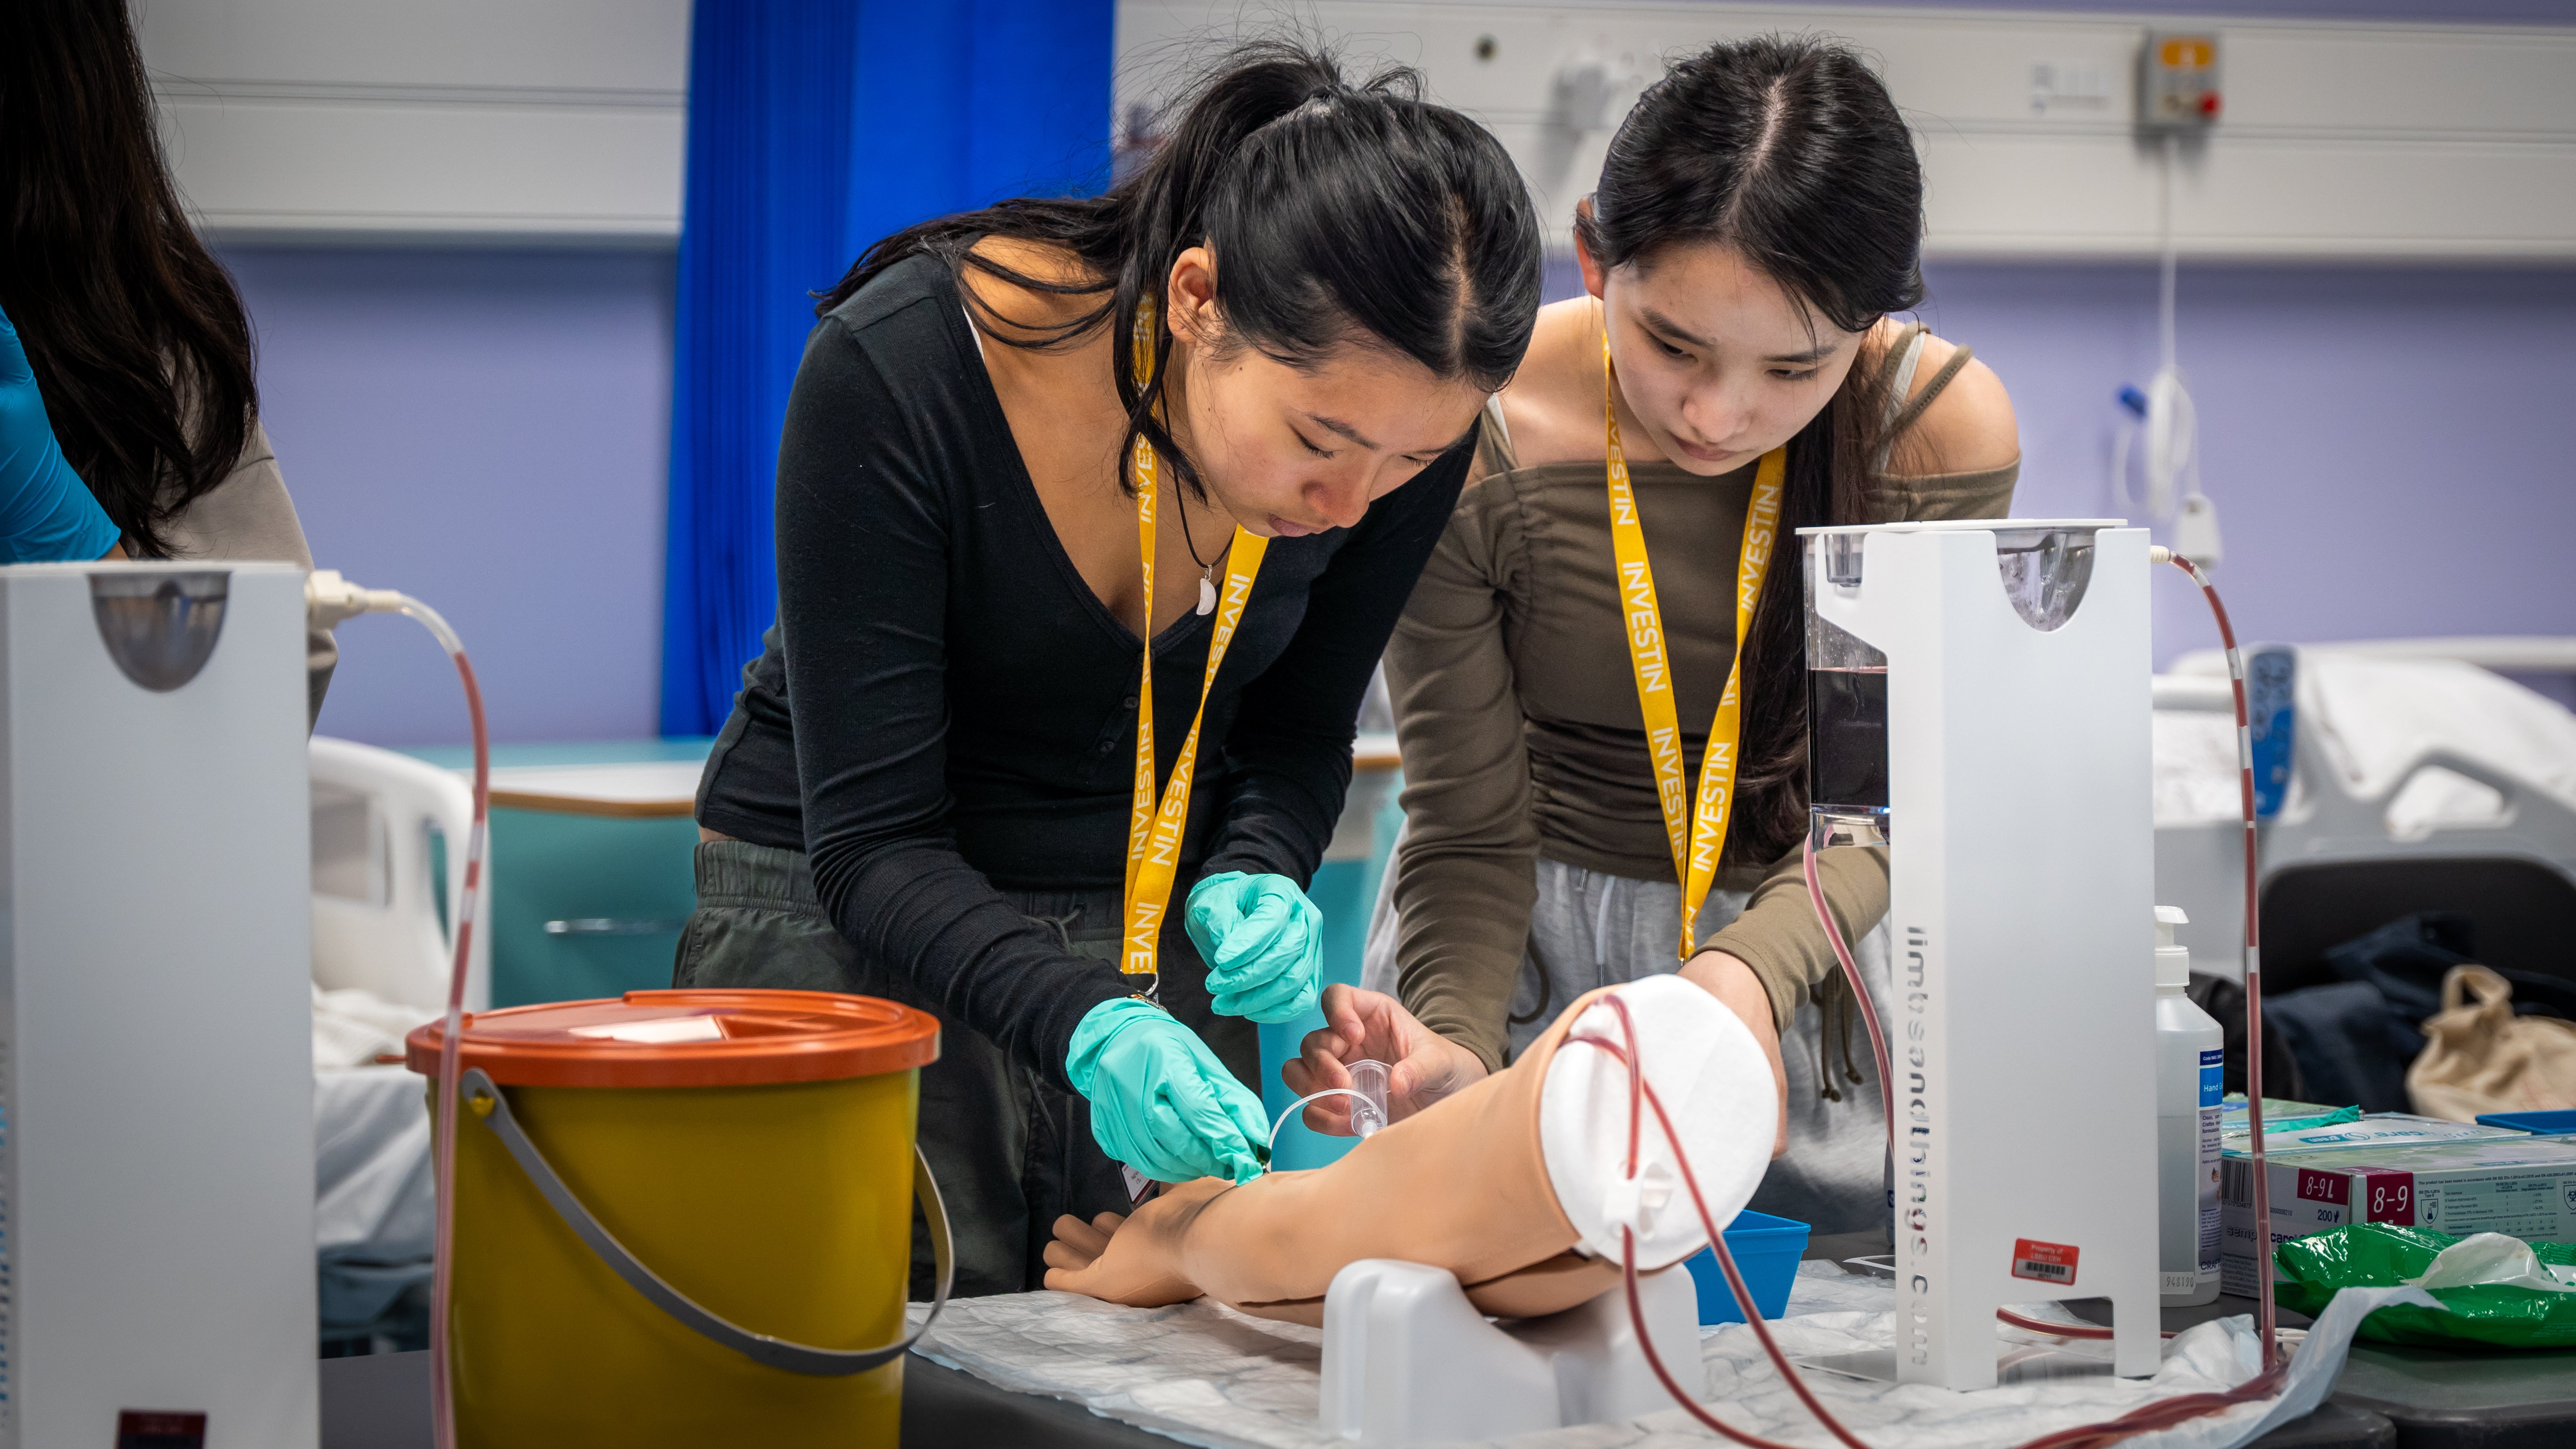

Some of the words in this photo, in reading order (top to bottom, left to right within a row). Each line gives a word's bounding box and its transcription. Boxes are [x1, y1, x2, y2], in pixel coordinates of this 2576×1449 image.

[1741, 484, 1779, 613] INVESTIN
[1205, 573, 1251, 694] INVEST
[1623, 561, 1666, 693] INVESTIN
[1132, 722, 1150, 860] INVESTIN
[1150, 729, 1197, 866] INVESTIN
[1652, 727, 1684, 860] INVESTIN
[1693, 743, 1731, 872] INVESTIN
[1130, 902, 1162, 974] INVE
[2204, 1083, 2218, 1092] Hand
[2306, 1176, 2326, 1197] 8-9
[2327, 1179, 2333, 1198] L
[2317, 1209, 2332, 1222] 200
[2373, 1185, 2408, 1213] 8-9
[2031, 1244, 2055, 1255] Property
[2166, 1276, 2194, 1287] 948190
